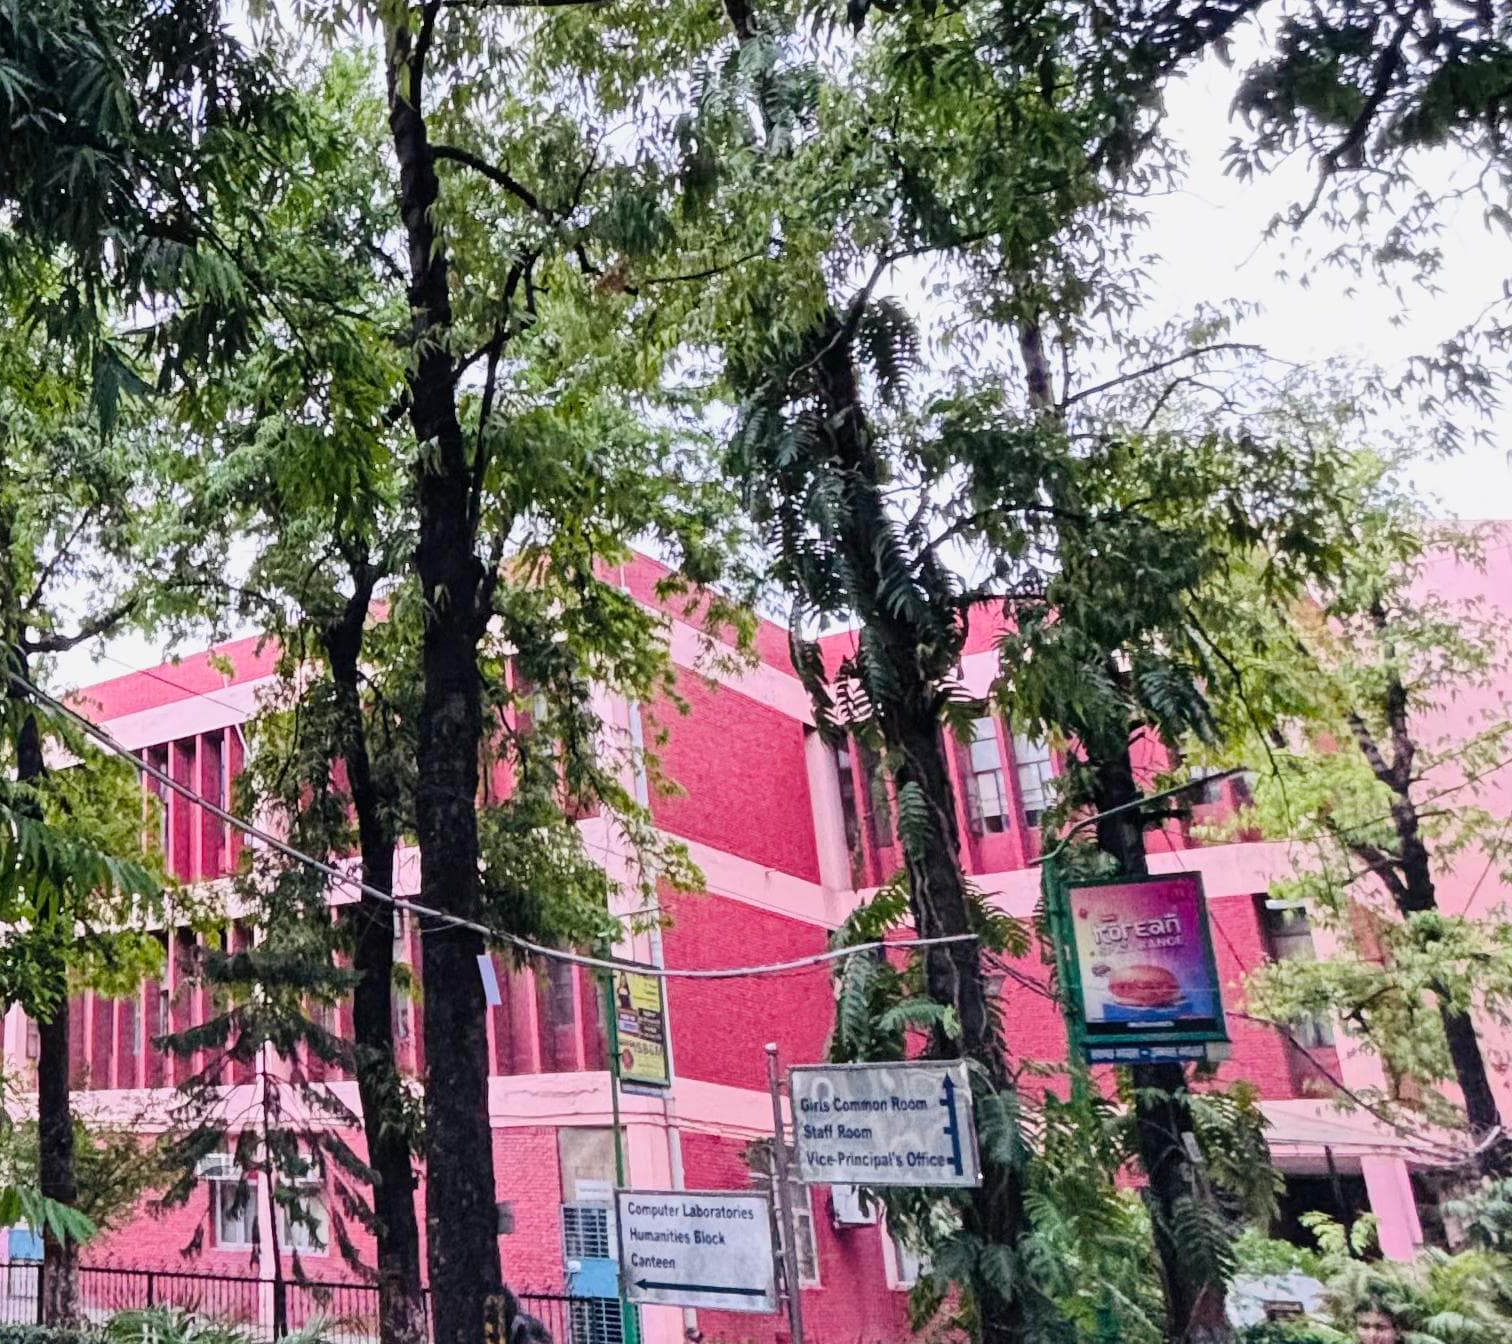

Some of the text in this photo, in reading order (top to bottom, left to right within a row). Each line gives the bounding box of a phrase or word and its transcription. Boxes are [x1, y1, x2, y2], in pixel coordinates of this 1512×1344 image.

[800, 1096, 928, 1113] Girls Common Room
[803, 1124, 873, 1140] Staff Room
[807, 1151, 945, 1170] Vice-Principal's Office
[627, 1201, 754, 1220] Computer Laboratories
[629, 1227, 726, 1245] Humanities Block
[631, 1252, 676, 1269] Canteen
